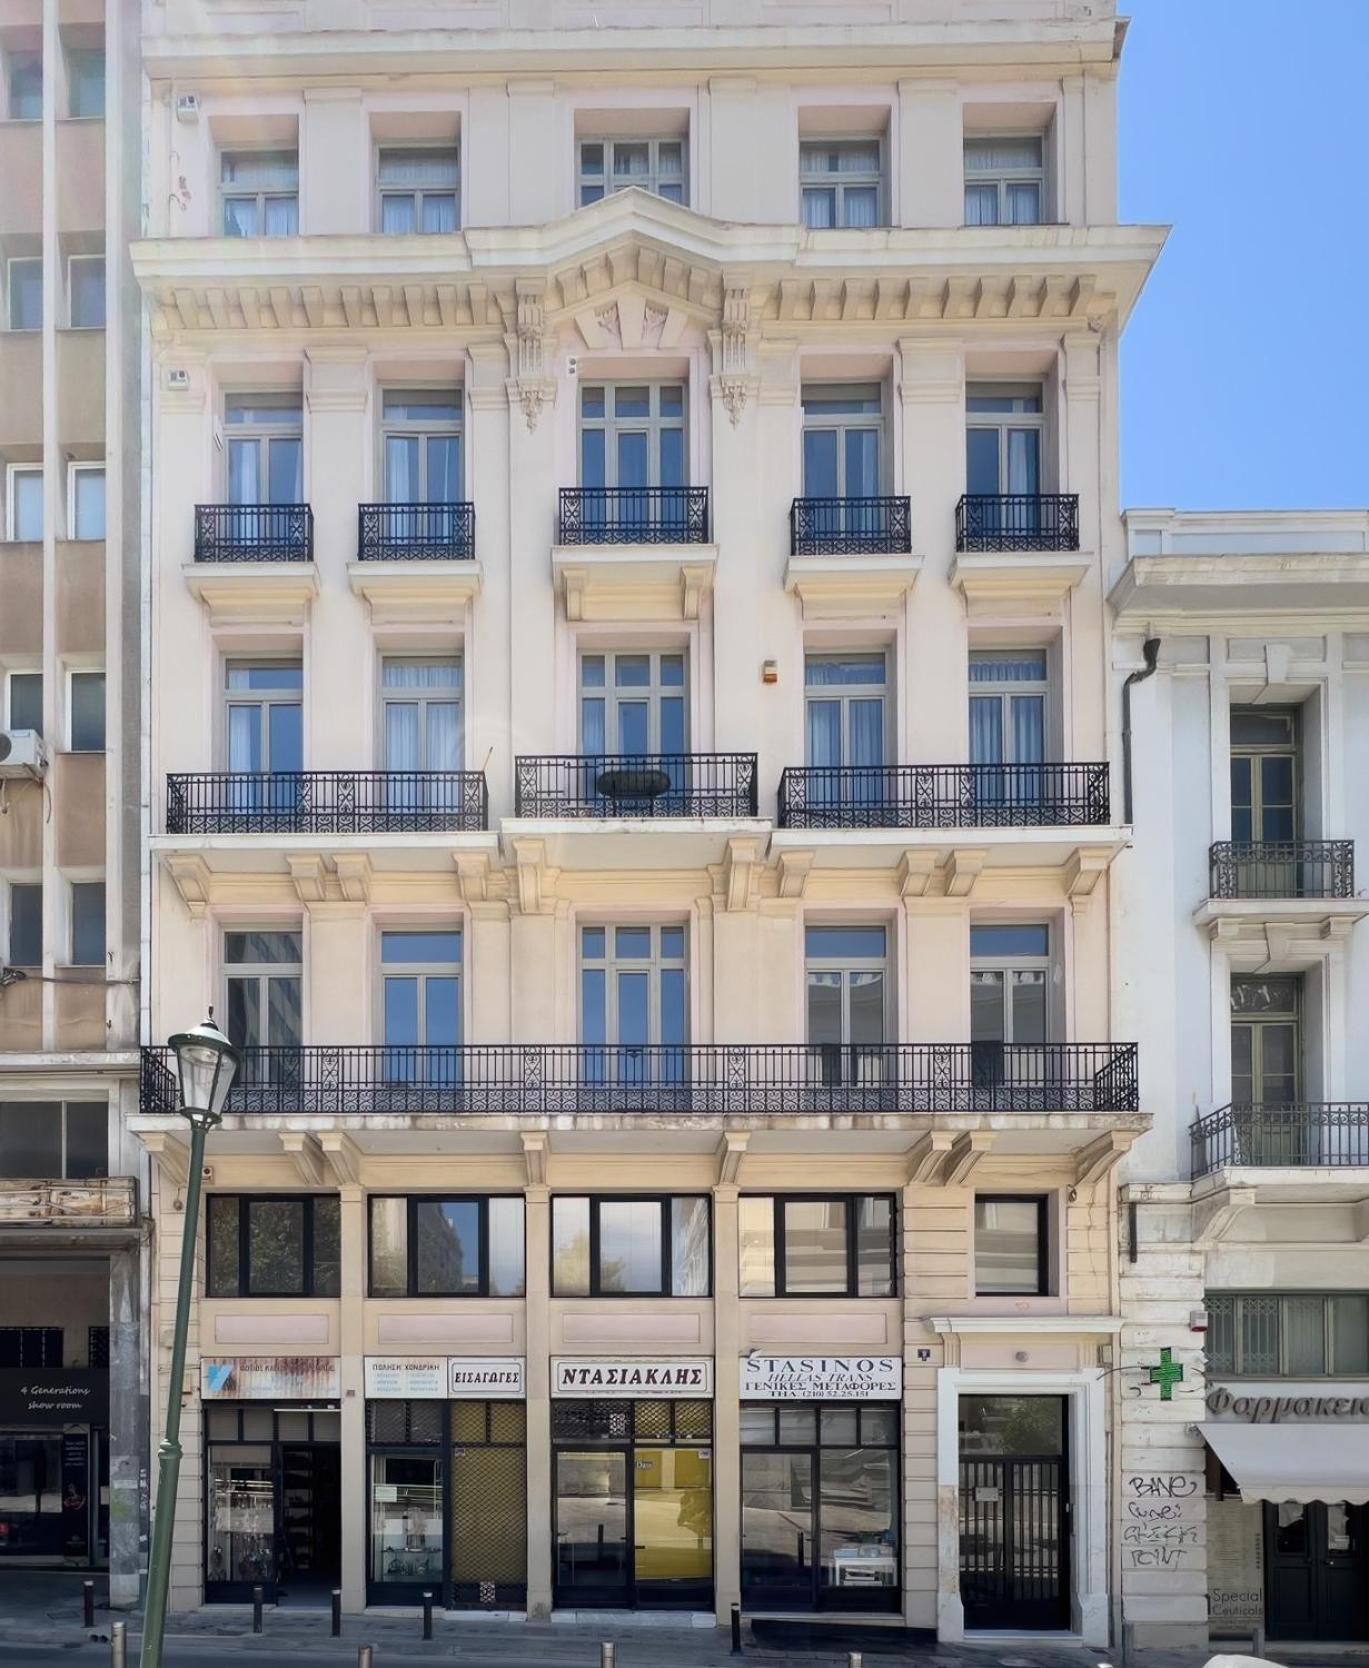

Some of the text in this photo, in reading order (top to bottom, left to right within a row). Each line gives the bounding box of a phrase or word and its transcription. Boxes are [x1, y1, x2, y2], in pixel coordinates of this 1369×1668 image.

[747, 1359, 893, 1372] STASINOS
[455, 1372, 519, 1384] ΕΙΣΑΓΩΓΕΣ
[562, 1369, 702, 1385] ΝΤΑΣΙΑΚΛΗΣ
[31, 1386, 90, 1395] Generations
[745, 1382, 896, 1390] ΓΕΝΙΚΕΣ ΜΕΤΑΦΟΡΕΣ
[28, 1401, 54, 1409] show
[1212, 1588, 1262, 1604] Special
